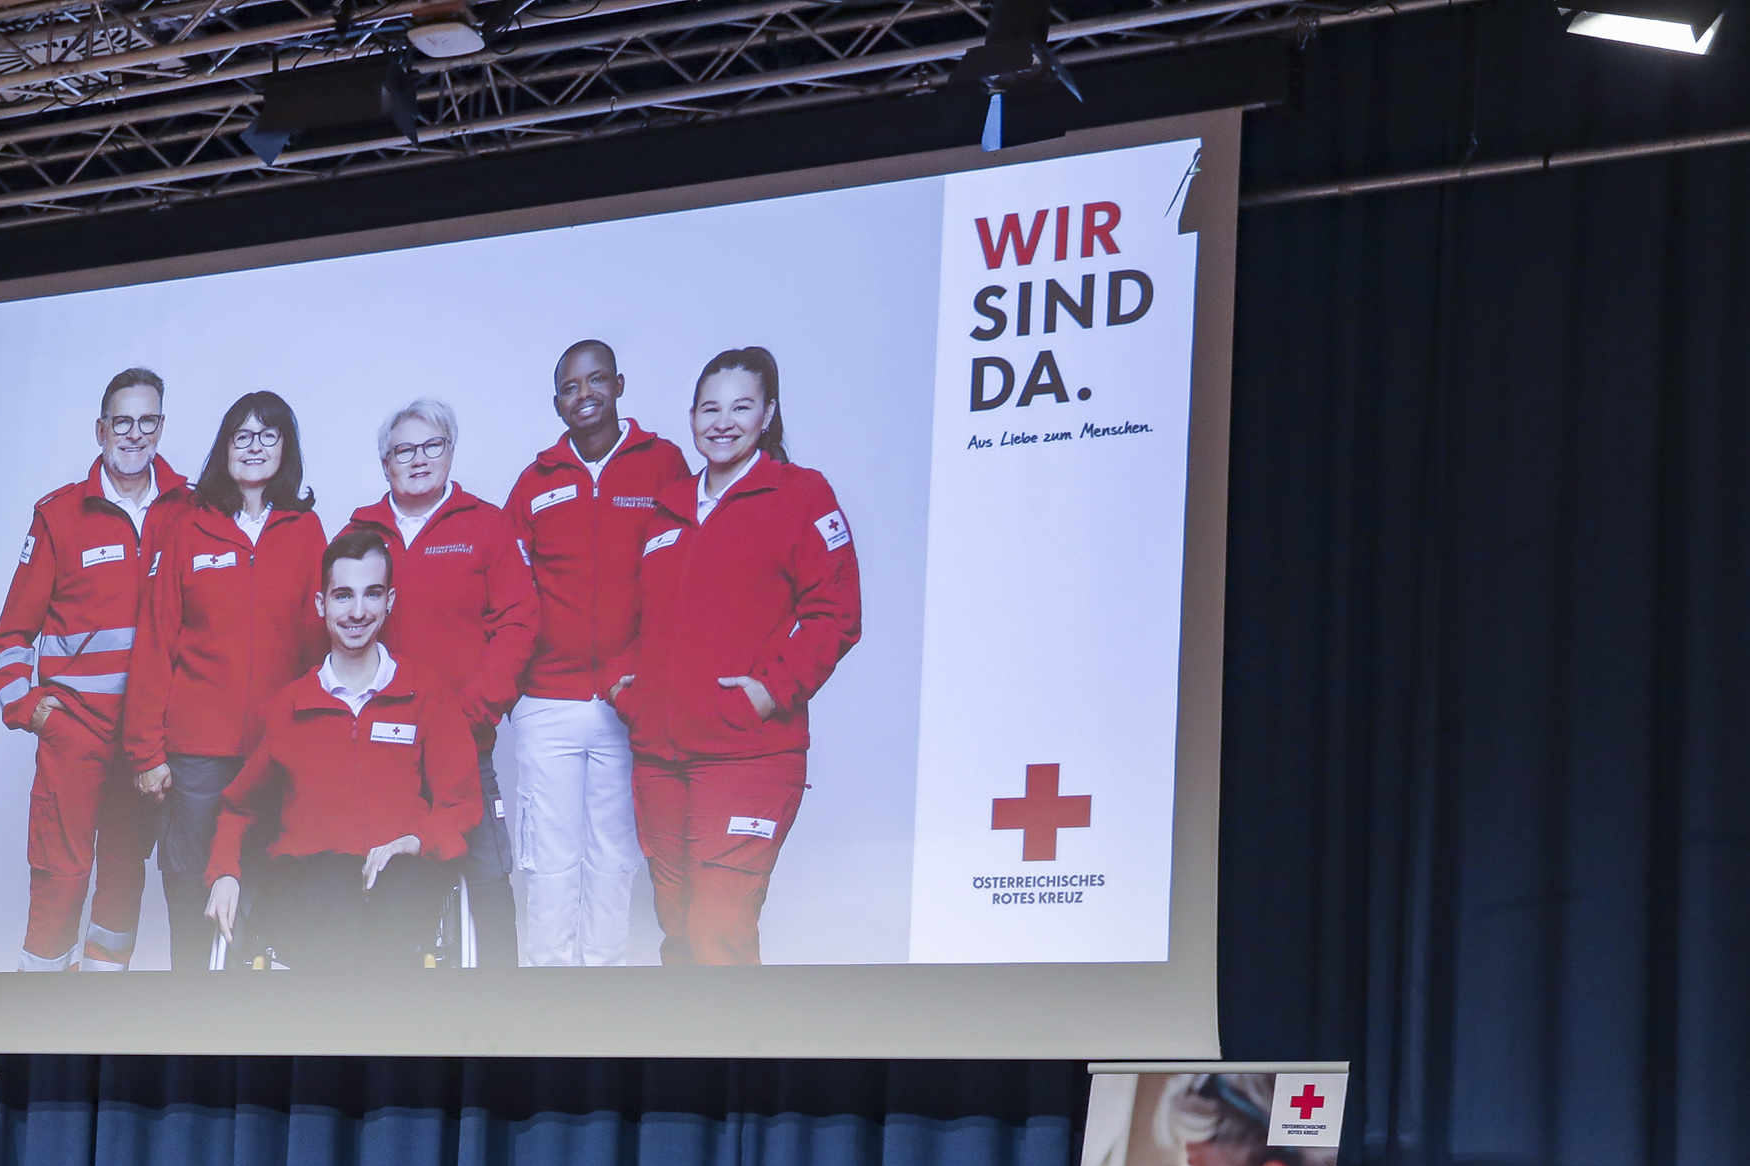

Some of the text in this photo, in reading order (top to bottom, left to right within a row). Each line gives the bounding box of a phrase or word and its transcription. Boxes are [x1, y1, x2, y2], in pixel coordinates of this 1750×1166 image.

[974, 200, 1121, 270] WIR
[969, 269, 1154, 342] SIND
[969, 350, 1092, 412] DA.
[967, 421, 1153, 449] Aus Liebe zum Menschen.
[972, 874, 1105, 889] ÖSTERREICHISCHES
[992, 891, 1083, 905] ROTES KREUZ
